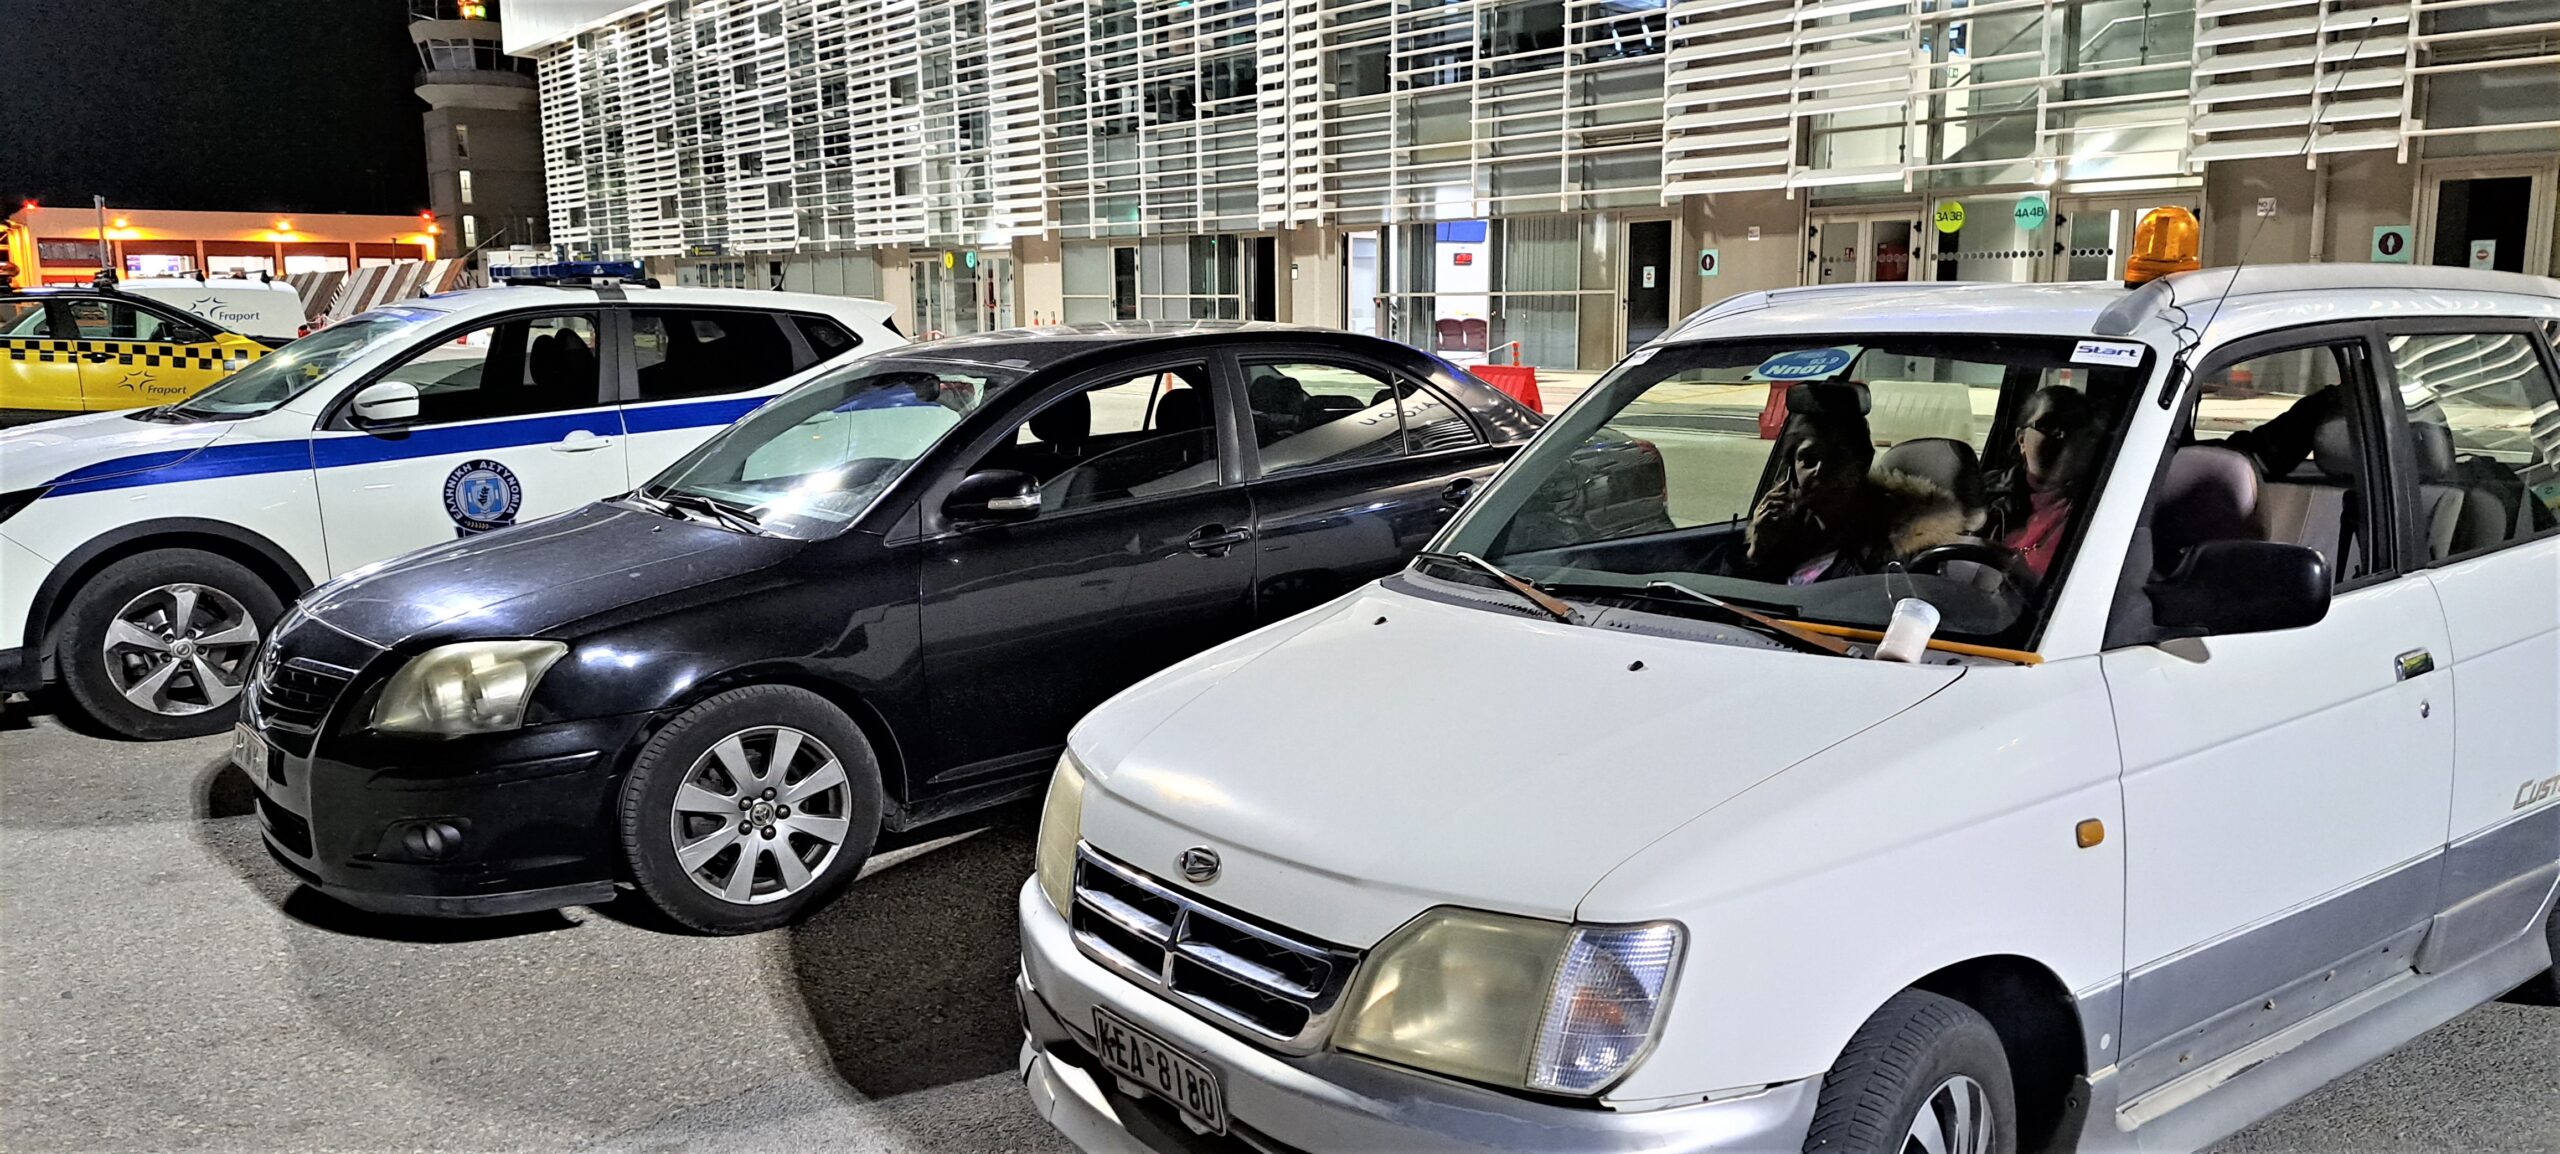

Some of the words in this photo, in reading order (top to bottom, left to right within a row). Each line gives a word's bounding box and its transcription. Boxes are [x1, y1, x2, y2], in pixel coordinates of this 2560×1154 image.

[219, 311, 260, 323] Fraport
[2076, 345, 2137, 358] Start
[147, 385, 187, 397] Fraport
[445, 463, 473, 520] ΕΛΛΗΝΙΚΗ
[479, 460, 520, 514] ΑΣΤΥΝΟΜΙΑ
[2512, 774, 2560, 811] CUST
[1098, 1017, 1216, 1121] KEA-8180
